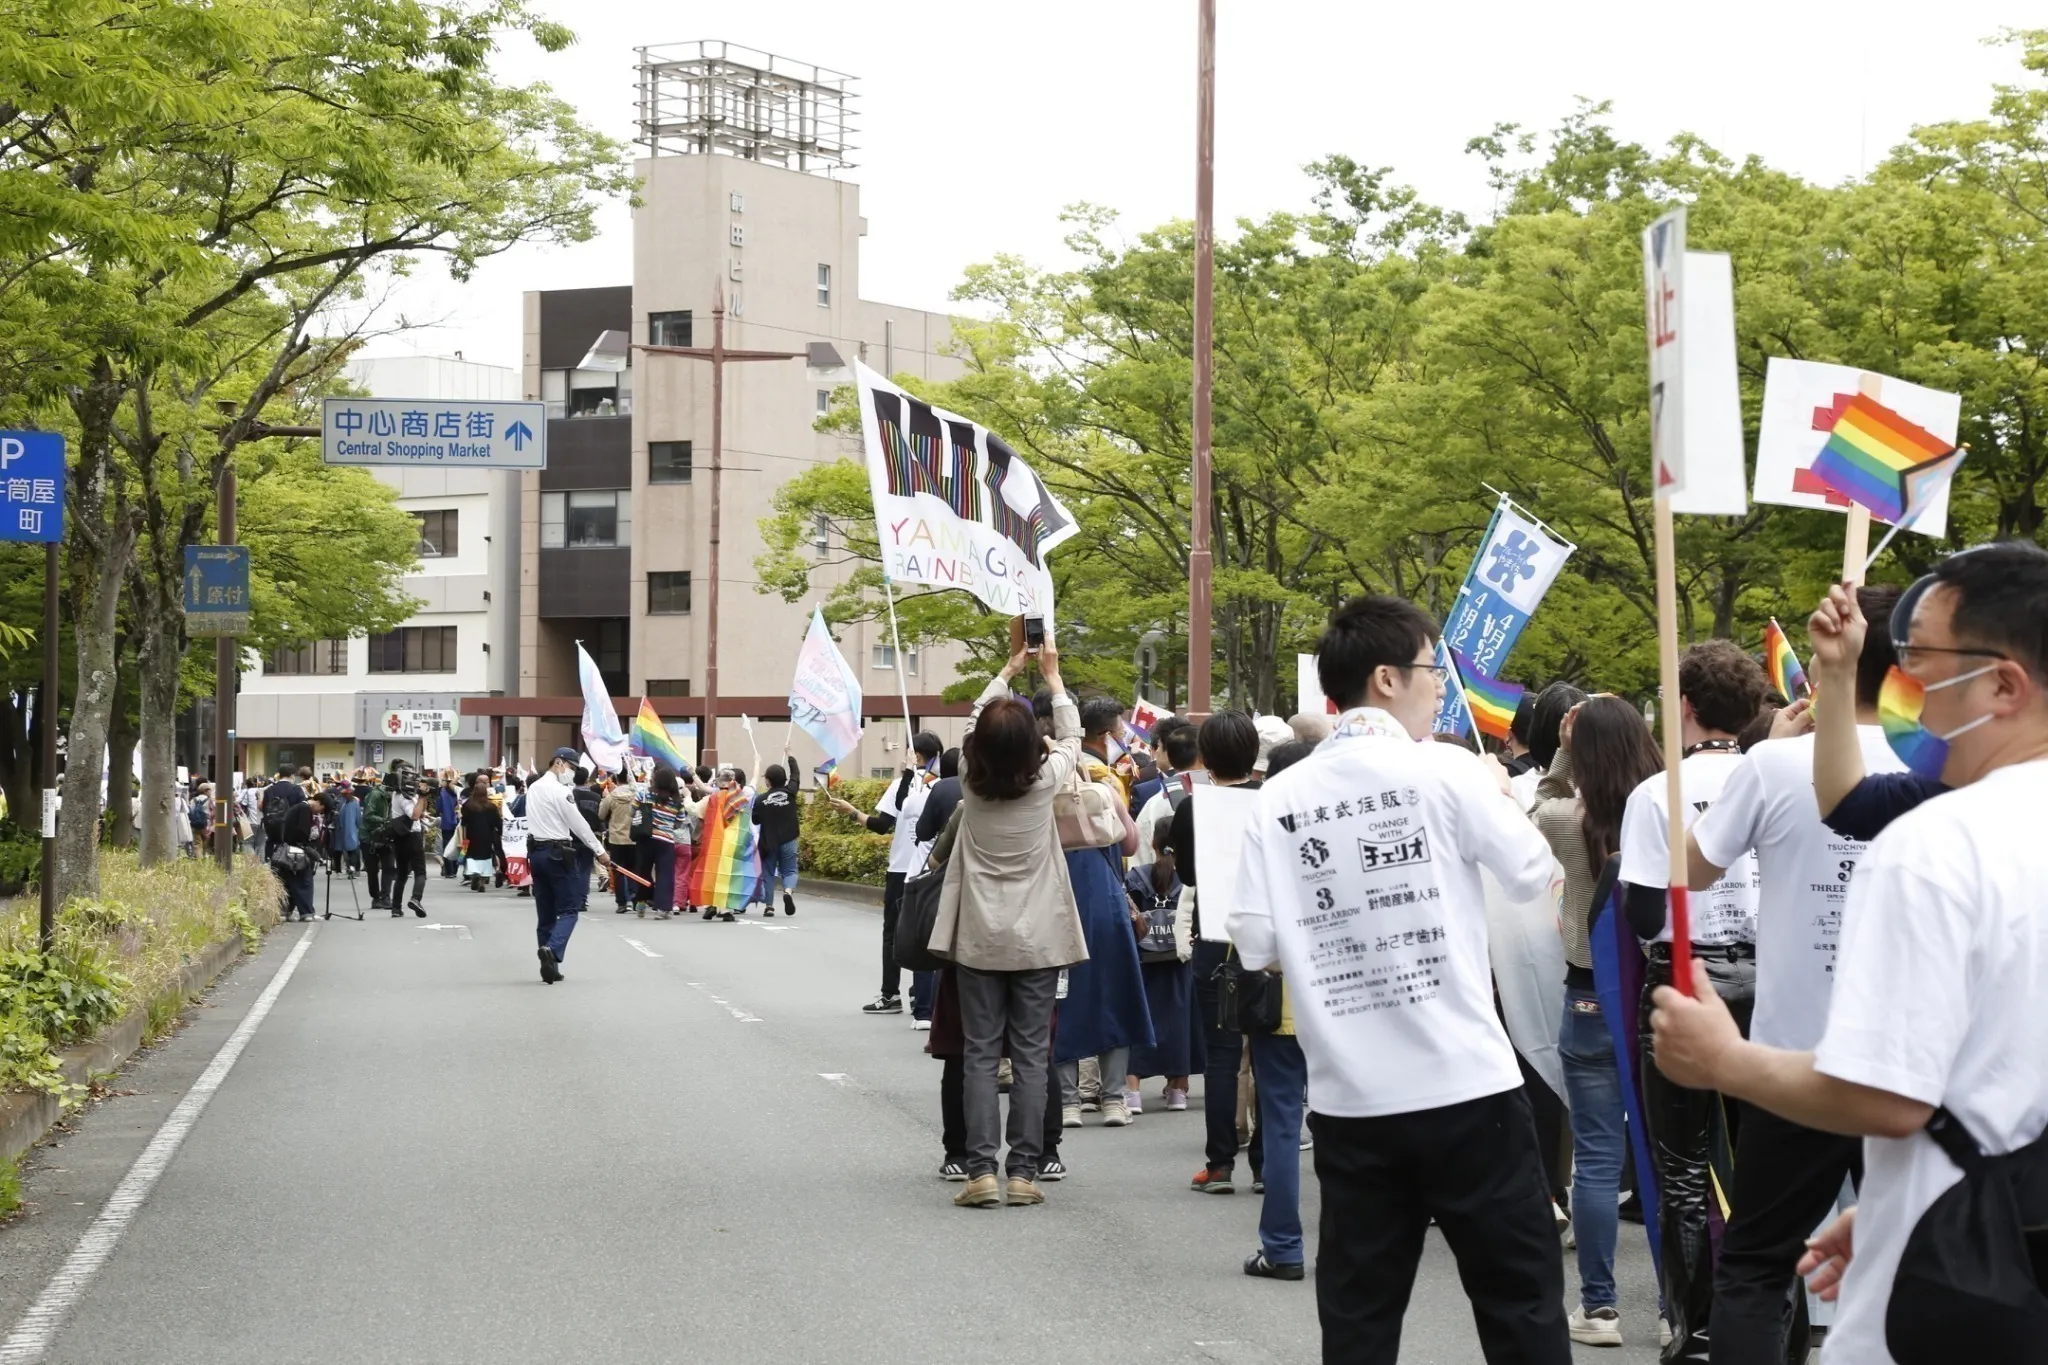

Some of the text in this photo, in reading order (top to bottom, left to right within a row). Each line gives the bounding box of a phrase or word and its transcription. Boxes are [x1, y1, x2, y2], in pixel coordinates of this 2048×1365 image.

[335, 408, 495, 439] 中心商店街
[1, 438, 25, 470] P
[337, 440, 491, 460] Central Shopping Market
[19, 509, 43, 534] 町
[1314, 790, 1401, 824] 東武住販
[1368, 817, 1409, 832] CHANGE
[1378, 829, 1403, 840] WITH
[1363, 837, 1423, 868] チェリオ
[1827, 843, 1867, 851] TSUCHIYA
[1301, 868, 1337, 881] TSUCHIYA
[1810, 883, 1847, 893] THREE
[1316, 887, 1335, 911] 3
[1296, 913, 1328, 927] THREE
[1331, 907, 1361, 920] ARROW
